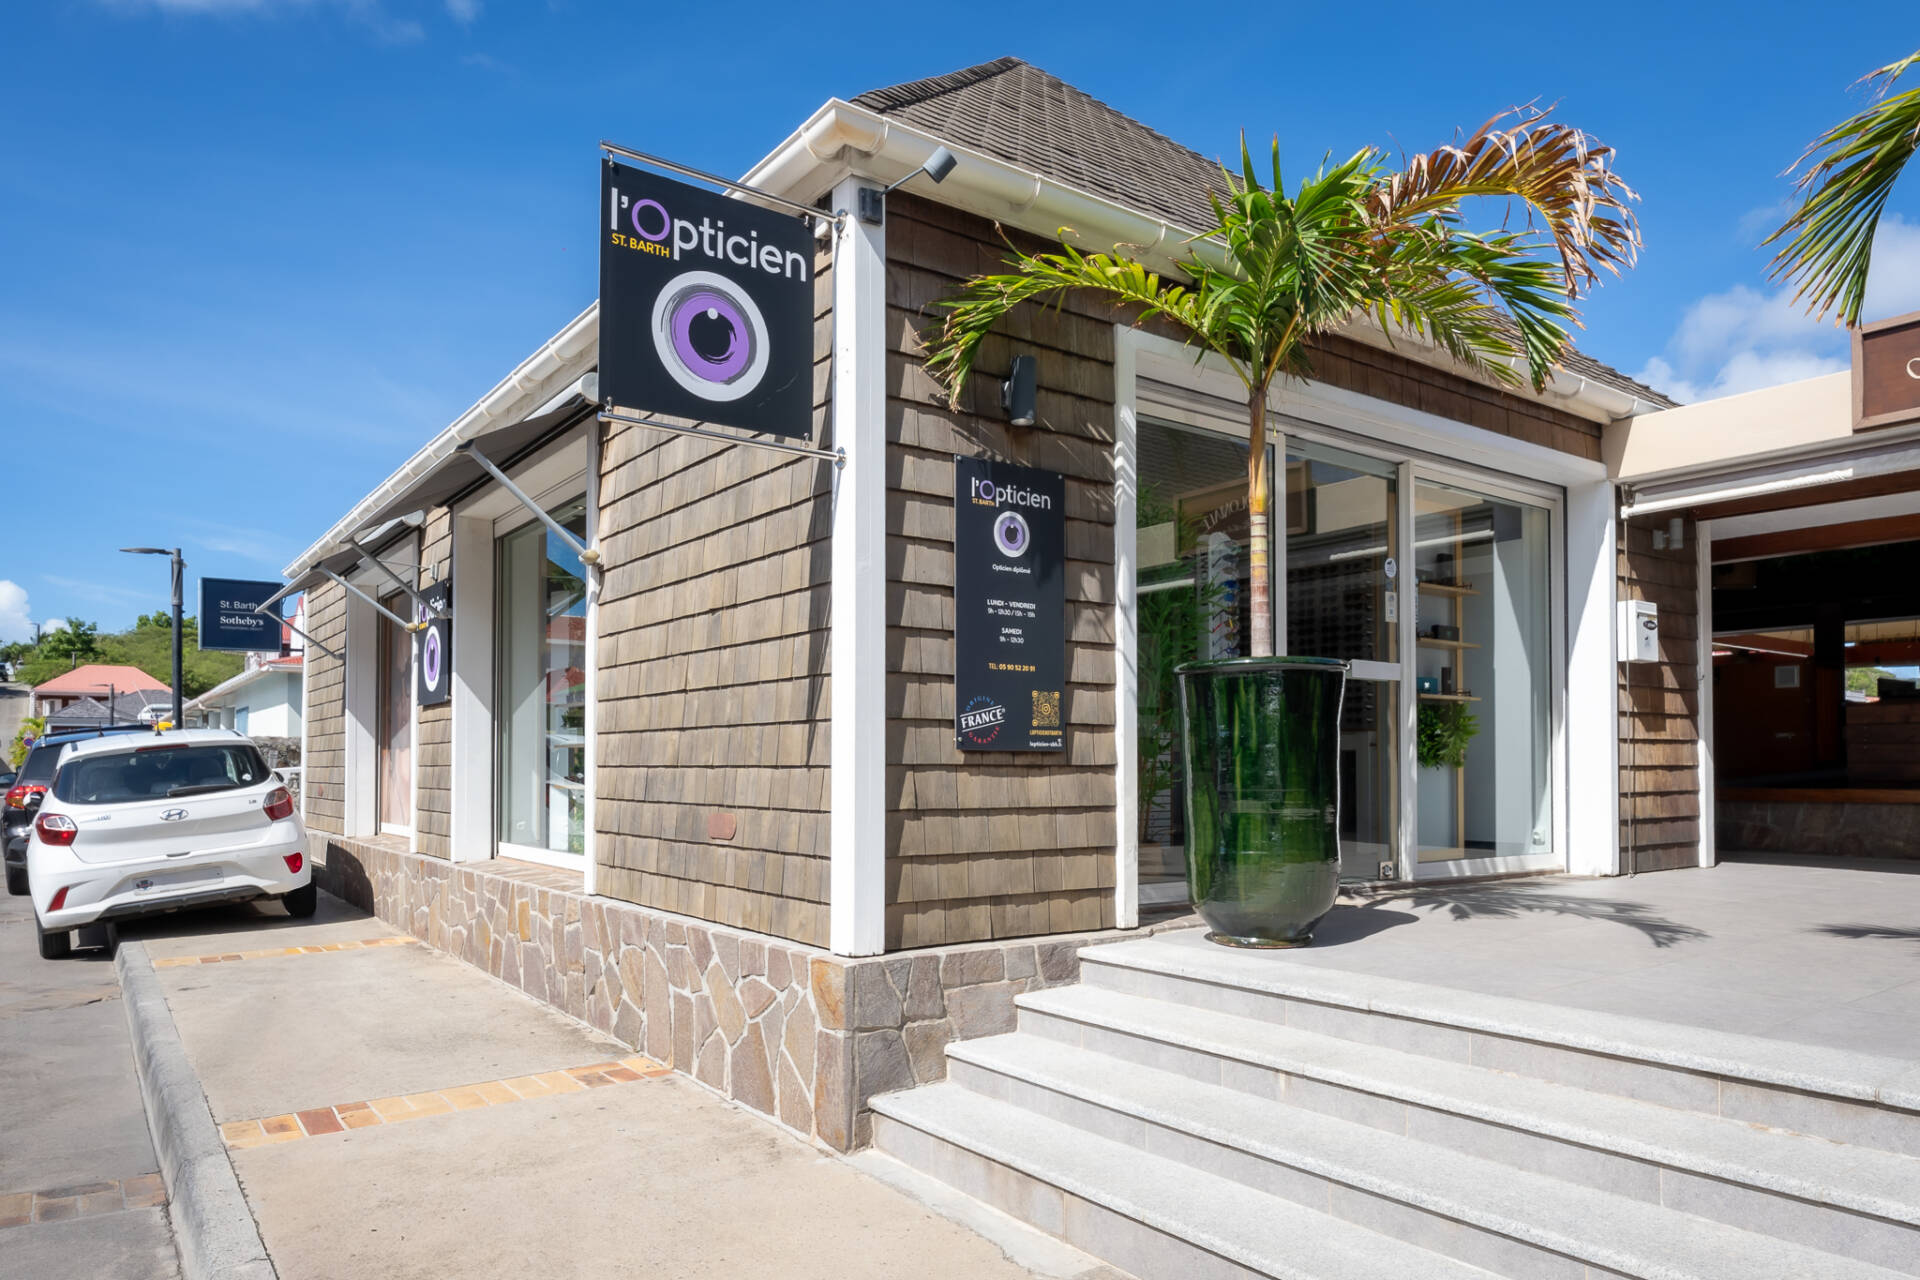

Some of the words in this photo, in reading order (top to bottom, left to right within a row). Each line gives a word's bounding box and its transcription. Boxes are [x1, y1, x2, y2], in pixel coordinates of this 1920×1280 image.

[610, 187, 807, 282] l'Opticien
[611, 232, 628, 248] ST.
[629, 237, 670, 258] BARTH
[971, 476, 1051, 510] l'Opticien
[992, 563, 1012, 572] Opticien
[234, 601, 258, 610] Barth
[1009, 601, 1036, 610] VENDREDI
[220, 616, 264, 627] Sotheby's
[1001, 627, 1022, 635] SAMEDI
